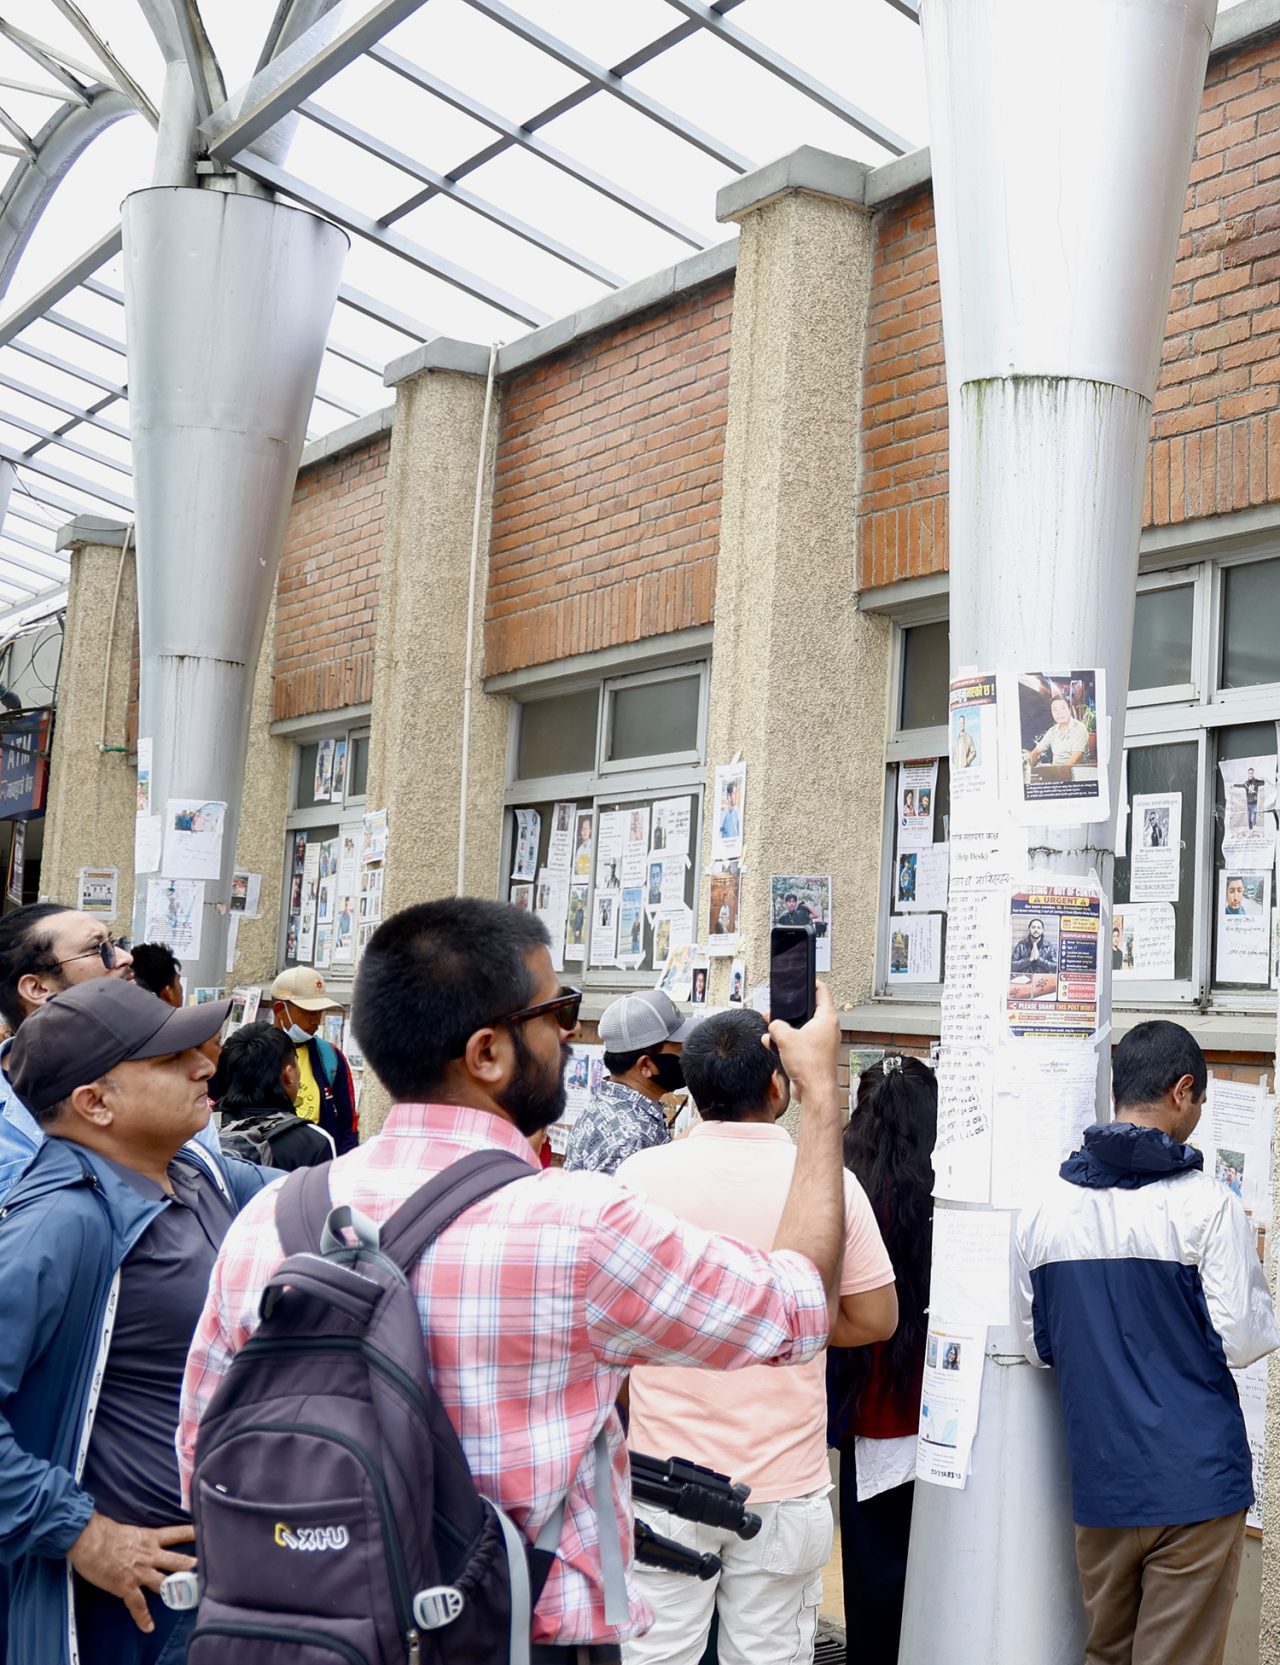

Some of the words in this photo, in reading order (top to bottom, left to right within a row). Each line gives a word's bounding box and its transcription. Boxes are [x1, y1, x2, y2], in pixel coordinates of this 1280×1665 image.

[7, 734, 32, 770] ATM
[1043, 896, 1078, 904] URGENT
[1018, 1002, 1037, 1010] PLEASE
[1056, 1003, 1067, 1011] THIS
